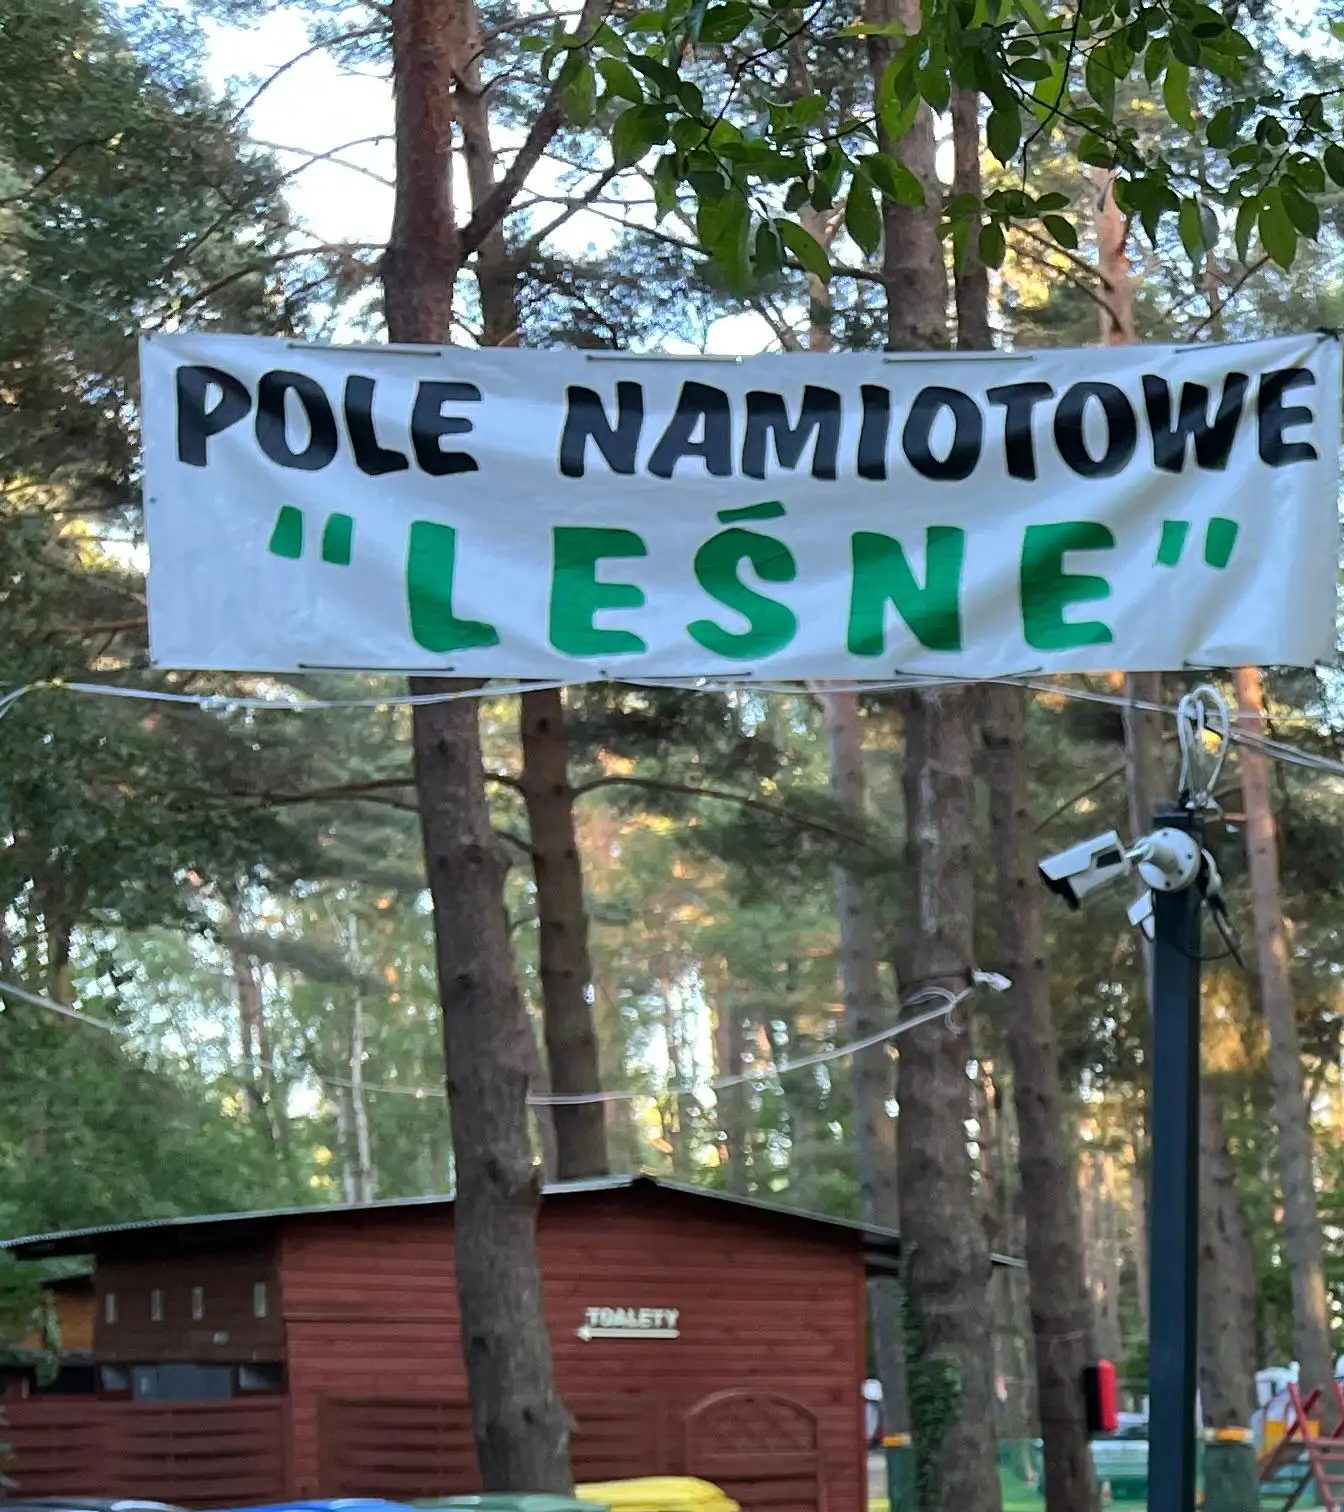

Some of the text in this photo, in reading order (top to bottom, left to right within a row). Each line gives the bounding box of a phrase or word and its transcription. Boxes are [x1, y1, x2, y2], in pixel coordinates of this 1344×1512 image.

[176, 365, 1319, 482] POLE NAMIOTOWE
[585, 1306, 680, 1329] TOALETY
